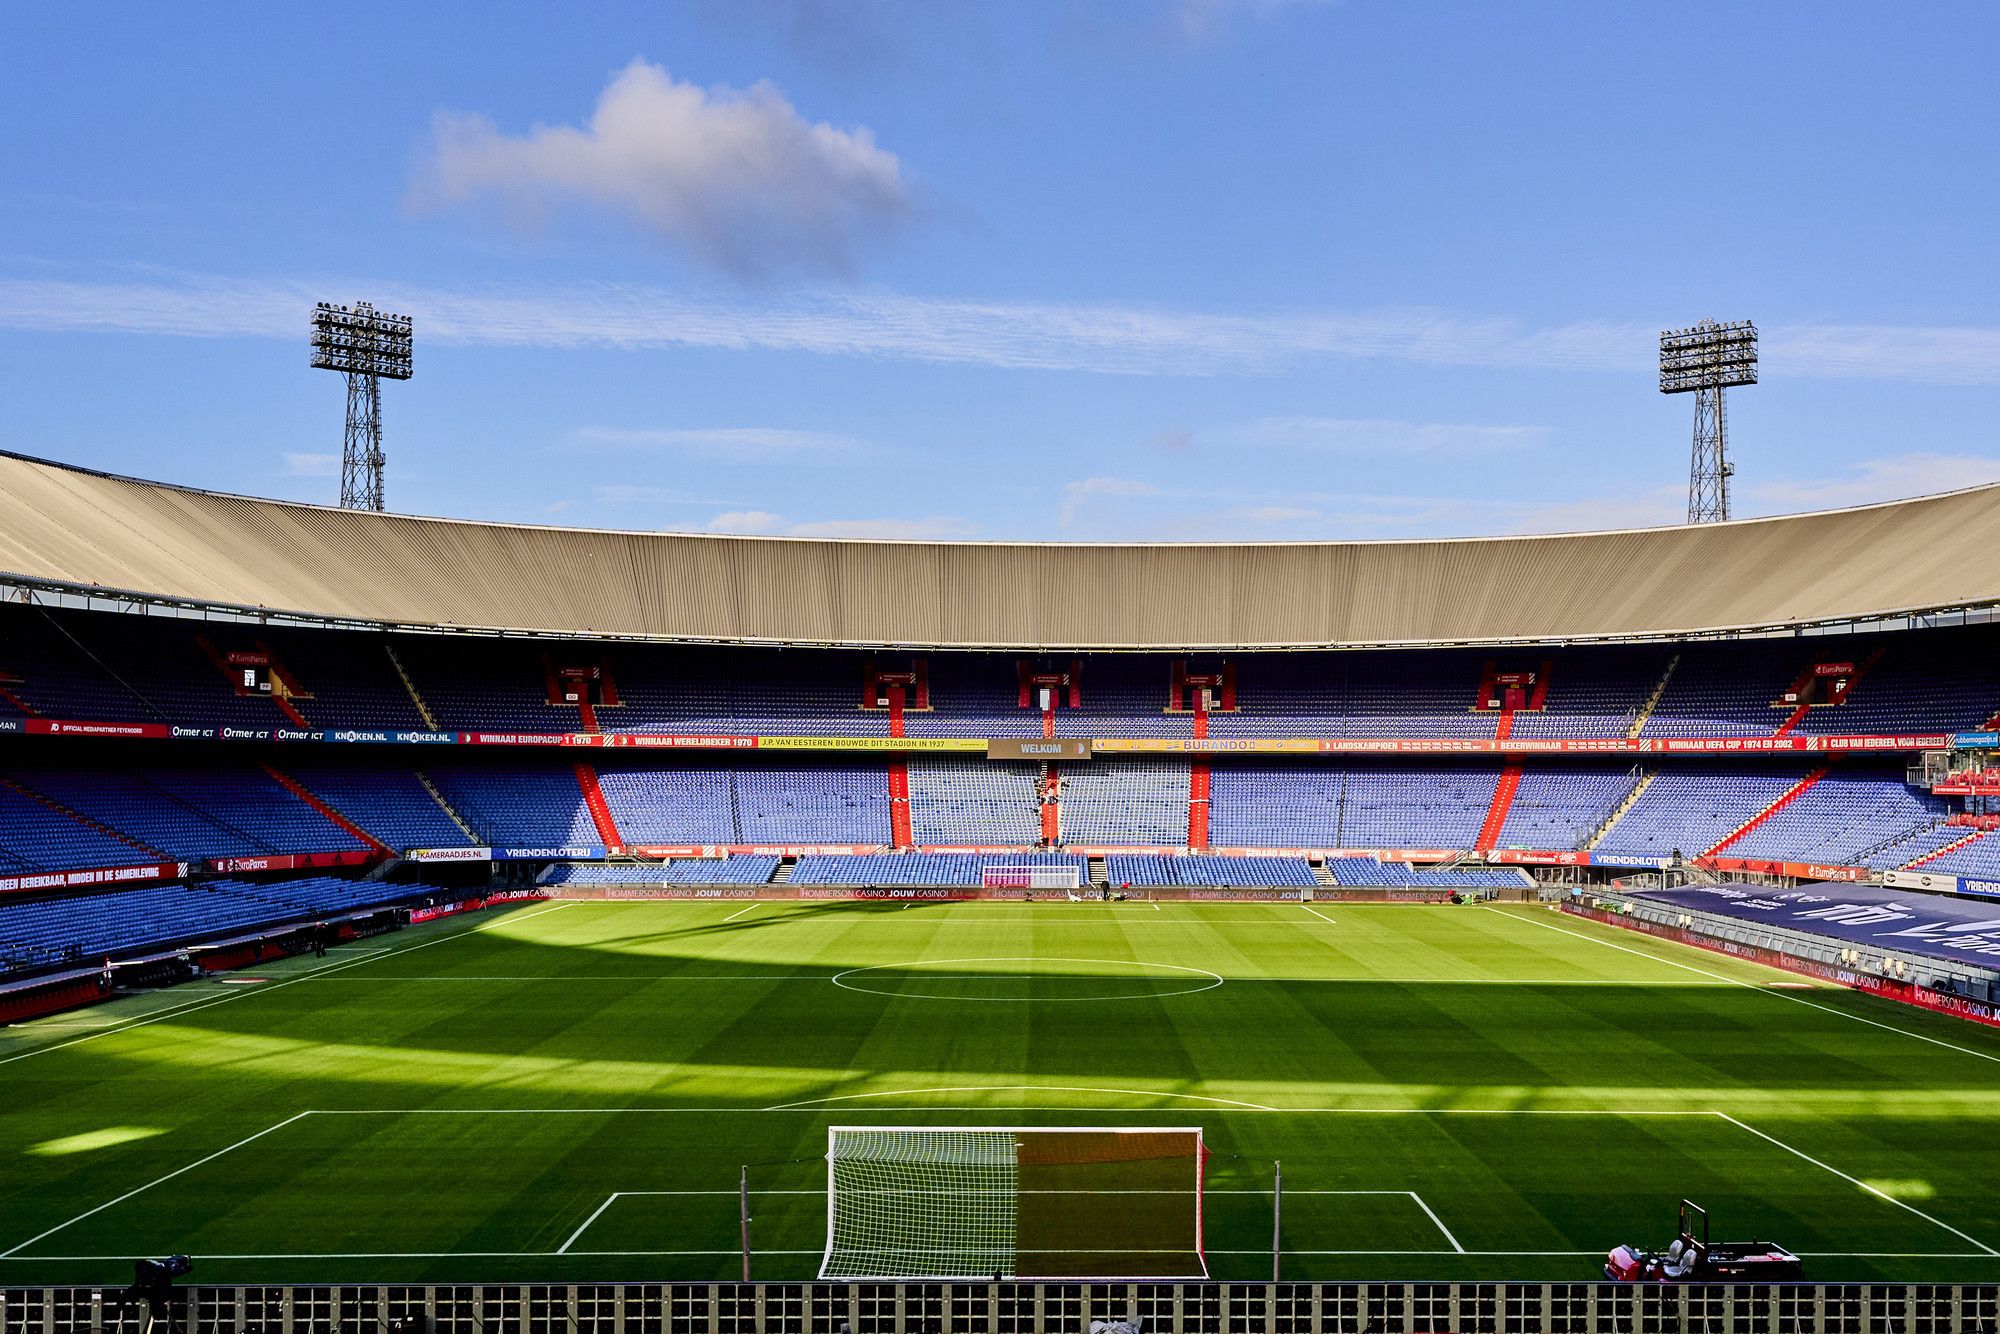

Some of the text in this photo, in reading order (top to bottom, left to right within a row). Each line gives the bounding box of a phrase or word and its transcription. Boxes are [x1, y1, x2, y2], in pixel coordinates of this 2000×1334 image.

[172, 726, 214, 737] Ormer ICT
[223, 727, 254, 738] Ormer
[278, 729, 308, 739] Ormer
[335, 731, 387, 742] KNAKEN.NL
[397, 732, 451, 743] KNAKEN.NL
[480, 734, 515, 743] WINNAAR
[518, 735, 563, 744] EUROPACUP
[635, 737, 752, 747] WINNAAR WERELDBEKER 1970
[1830, 739, 1848, 748] CLUB
[1850, 739, 1863, 748] VAN
[1898, 737, 1915, 747] VOOR
[793, 739, 833, 747] EESTEREN
[929, 740, 945, 748] 1937
[1020, 743, 1062, 754] WELKOM
[1183, 740, 1248, 750] BURANDO
[1333, 741, 1398, 750] LANDSKAMPIOEN
[1500, 741, 1562, 750] BEKERWINNAAR
[1668, 740, 1793, 750] WINNAAR UEFA CUP 1974 EN 2002
[419, 850, 483, 859] KAMERAADJES.NL
[506, 848, 591, 858] VRIENDENLOTERIJ
[20, 874, 67, 889] BEREIKBAAR,
[68, 872, 95, 885] MIDDEN
[96, 871, 103, 882] IN
[104, 870, 114, 881] DE
[115, 867, 160, 880] SAMENLEVING
[509, 889, 530, 899] JOUW
[608, 888, 660, 898] HOMMERSON
[695, 889, 722, 898] JOUW
[723, 889, 756, 898] CASINO!
[802, 889, 854, 898] HOMMERSON
[888, 889, 916, 898] JOUW
[917, 889, 949, 898] CASINO!
[1192, 890, 1245, 899] HOMMERSON
[1836, 971, 1856, 984] JOUW
[1915, 990, 1961, 1012] HOMMERSON
